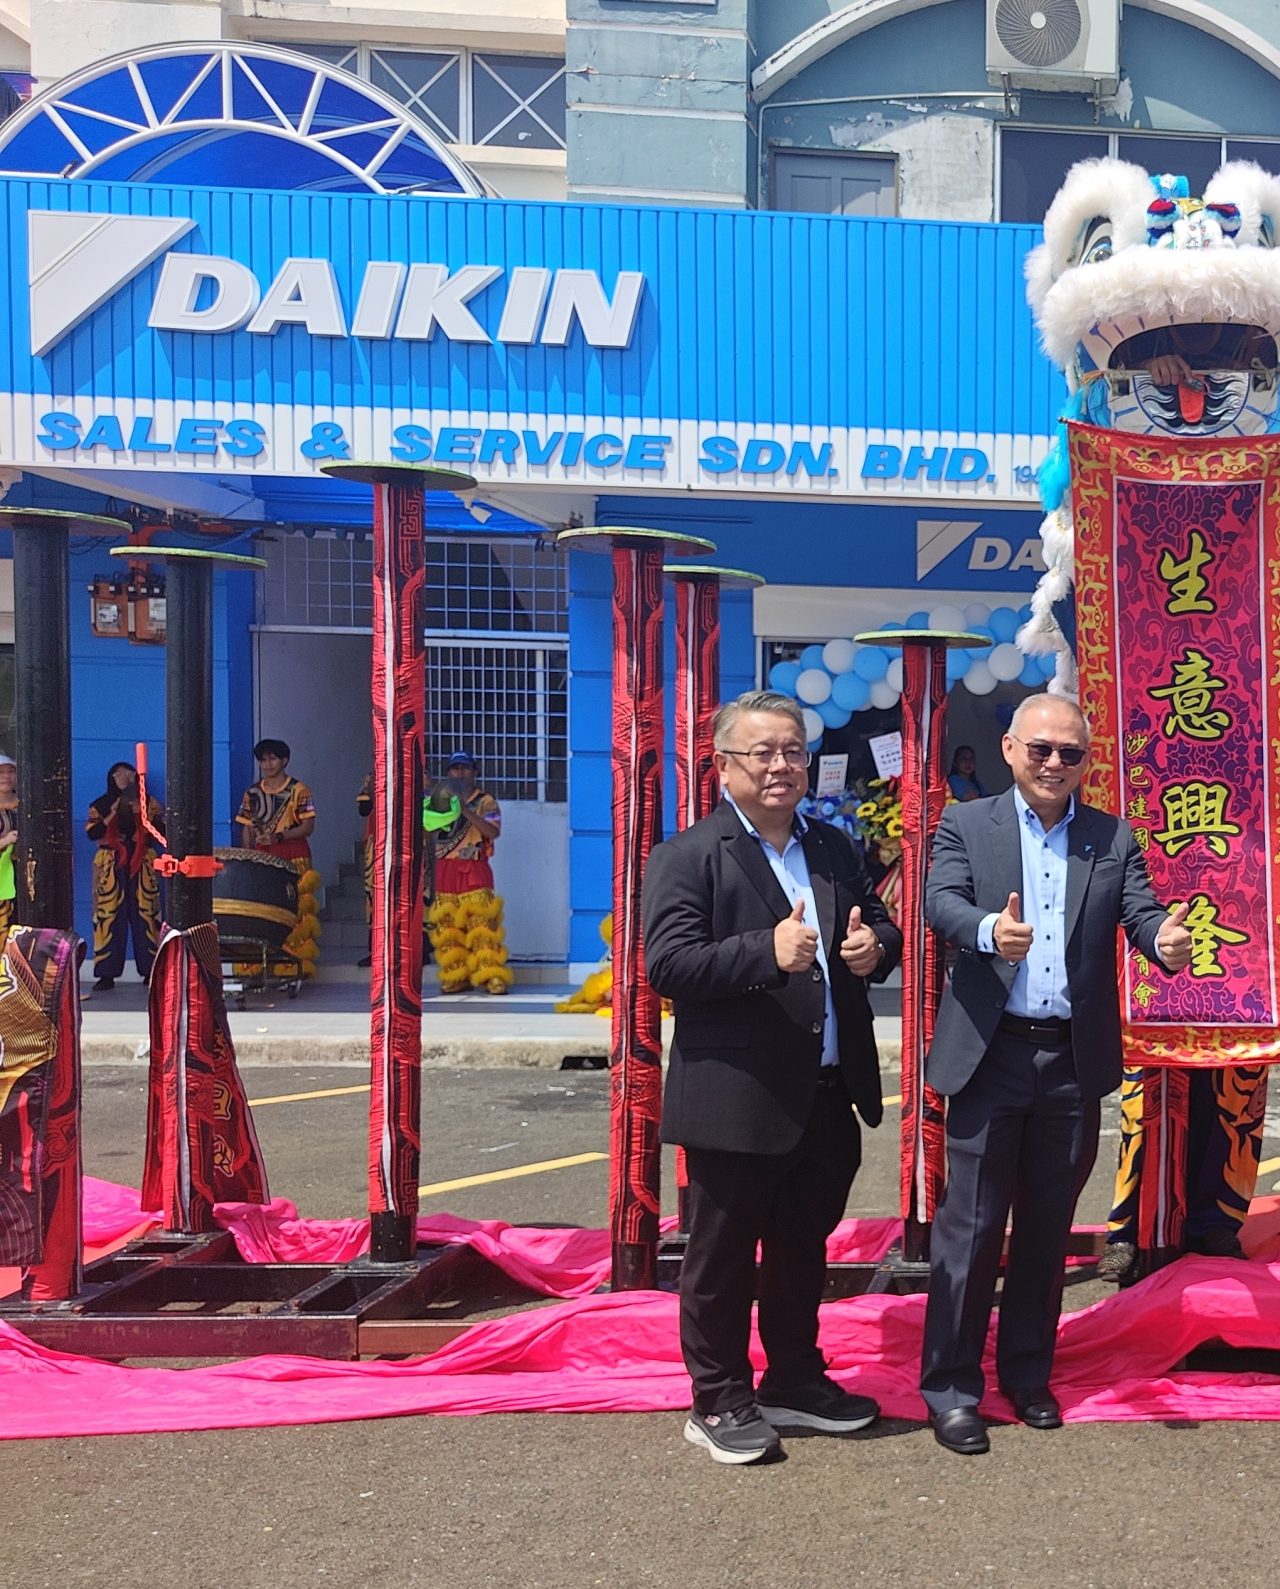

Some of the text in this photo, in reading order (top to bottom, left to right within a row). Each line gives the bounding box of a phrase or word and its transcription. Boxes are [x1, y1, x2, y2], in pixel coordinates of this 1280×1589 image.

[148, 252, 645, 348] DAIKIN
[37, 412, 265, 457] SALES
[300, 421, 350, 460] &
[390, 424, 671, 470] SERVICE
[699, 436, 840, 476] SDN.
[861, 444, 996, 483] BHD.
[1149, 531, 1248, 977] 生意興隆
